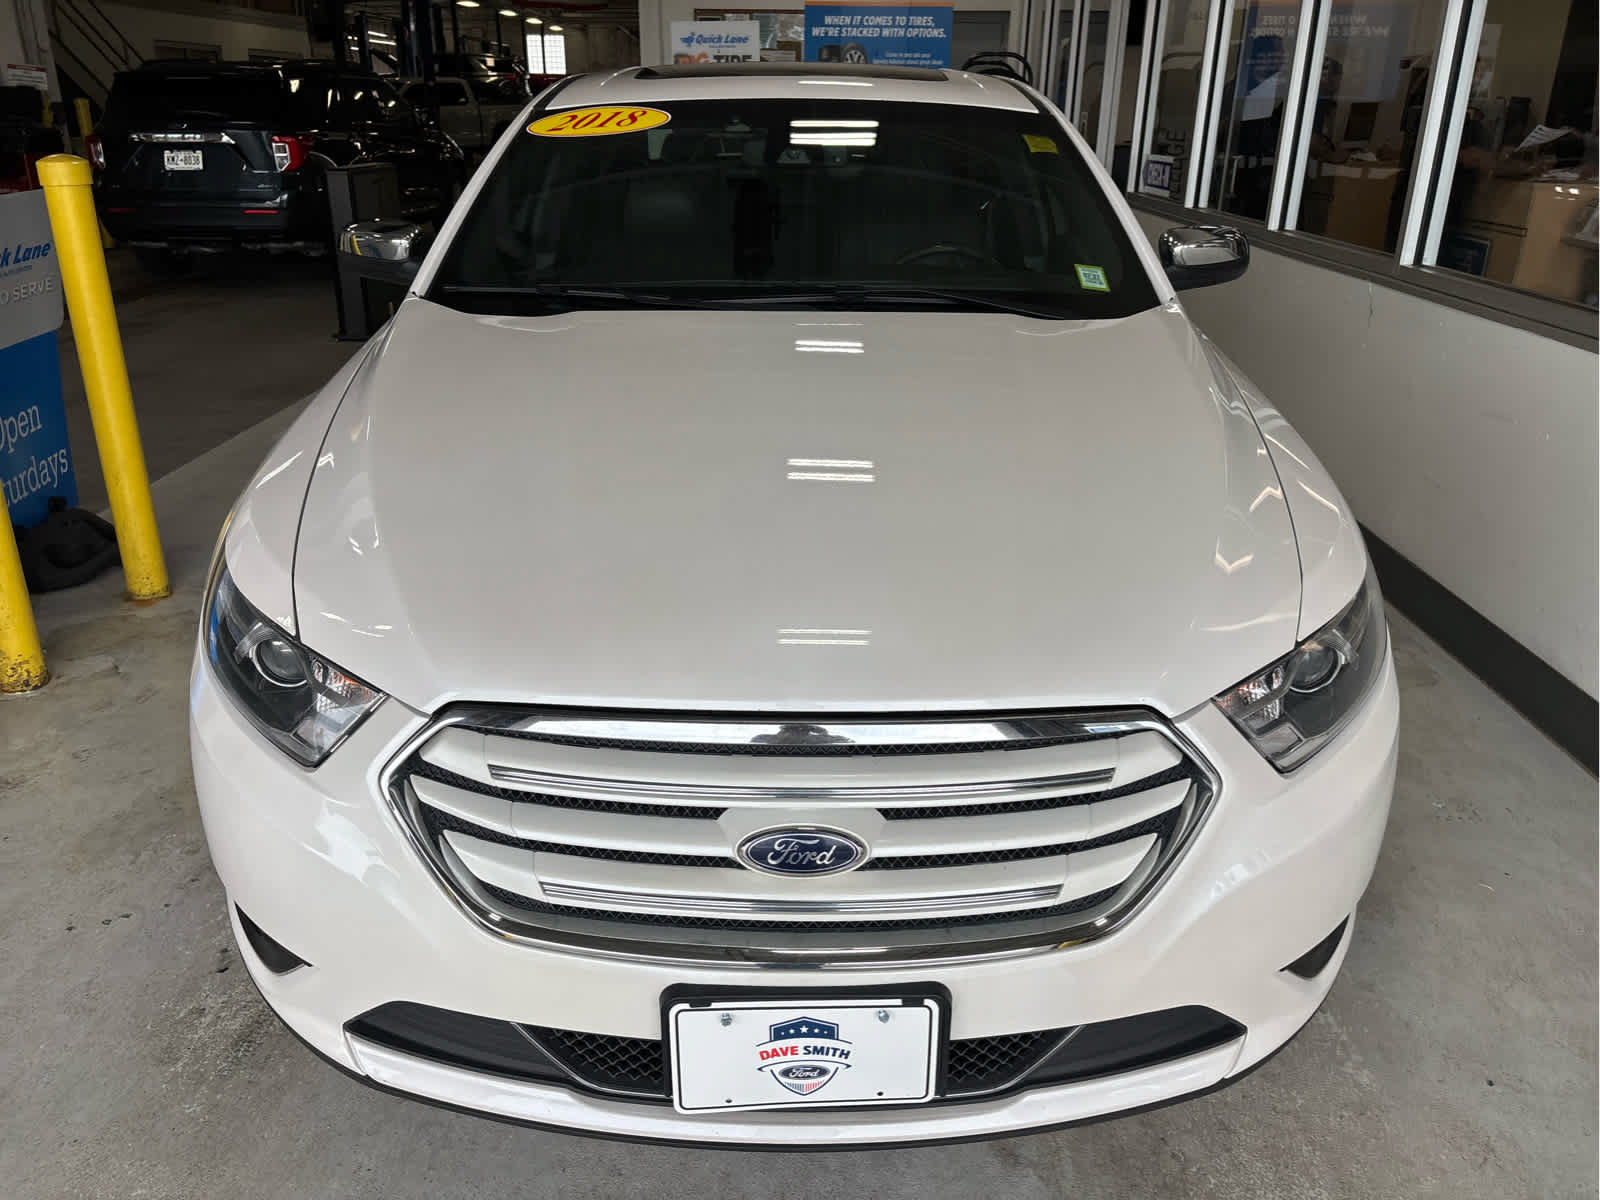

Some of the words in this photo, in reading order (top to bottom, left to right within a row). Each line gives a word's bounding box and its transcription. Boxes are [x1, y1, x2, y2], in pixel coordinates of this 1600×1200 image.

[824, 15, 852, 25] WHEN
[852, 16, 862, 25] IT
[863, 15, 893, 26] COMES
[895, 16, 907, 26] TO
[908, 16, 936, 27] TIRES,
[695, 34, 723, 45] Quick
[724, 34, 749, 44] Lane
[811, 26, 840, 37] WE'RE
[841, 27, 881, 38] STACKED
[881, 28, 905, 38] WITH
[545, 110, 648, 132] 2018
[13, 242, 52, 265] Lane
[12, 278, 54, 301] SERVE
[3, 447, 69, 506] urdays
[767, 838, 836, 865] Ford
[759, 1045, 800, 1061] DAVE
[802, 1045, 851, 1060] SMITH
[789, 1067, 821, 1078] Ford
